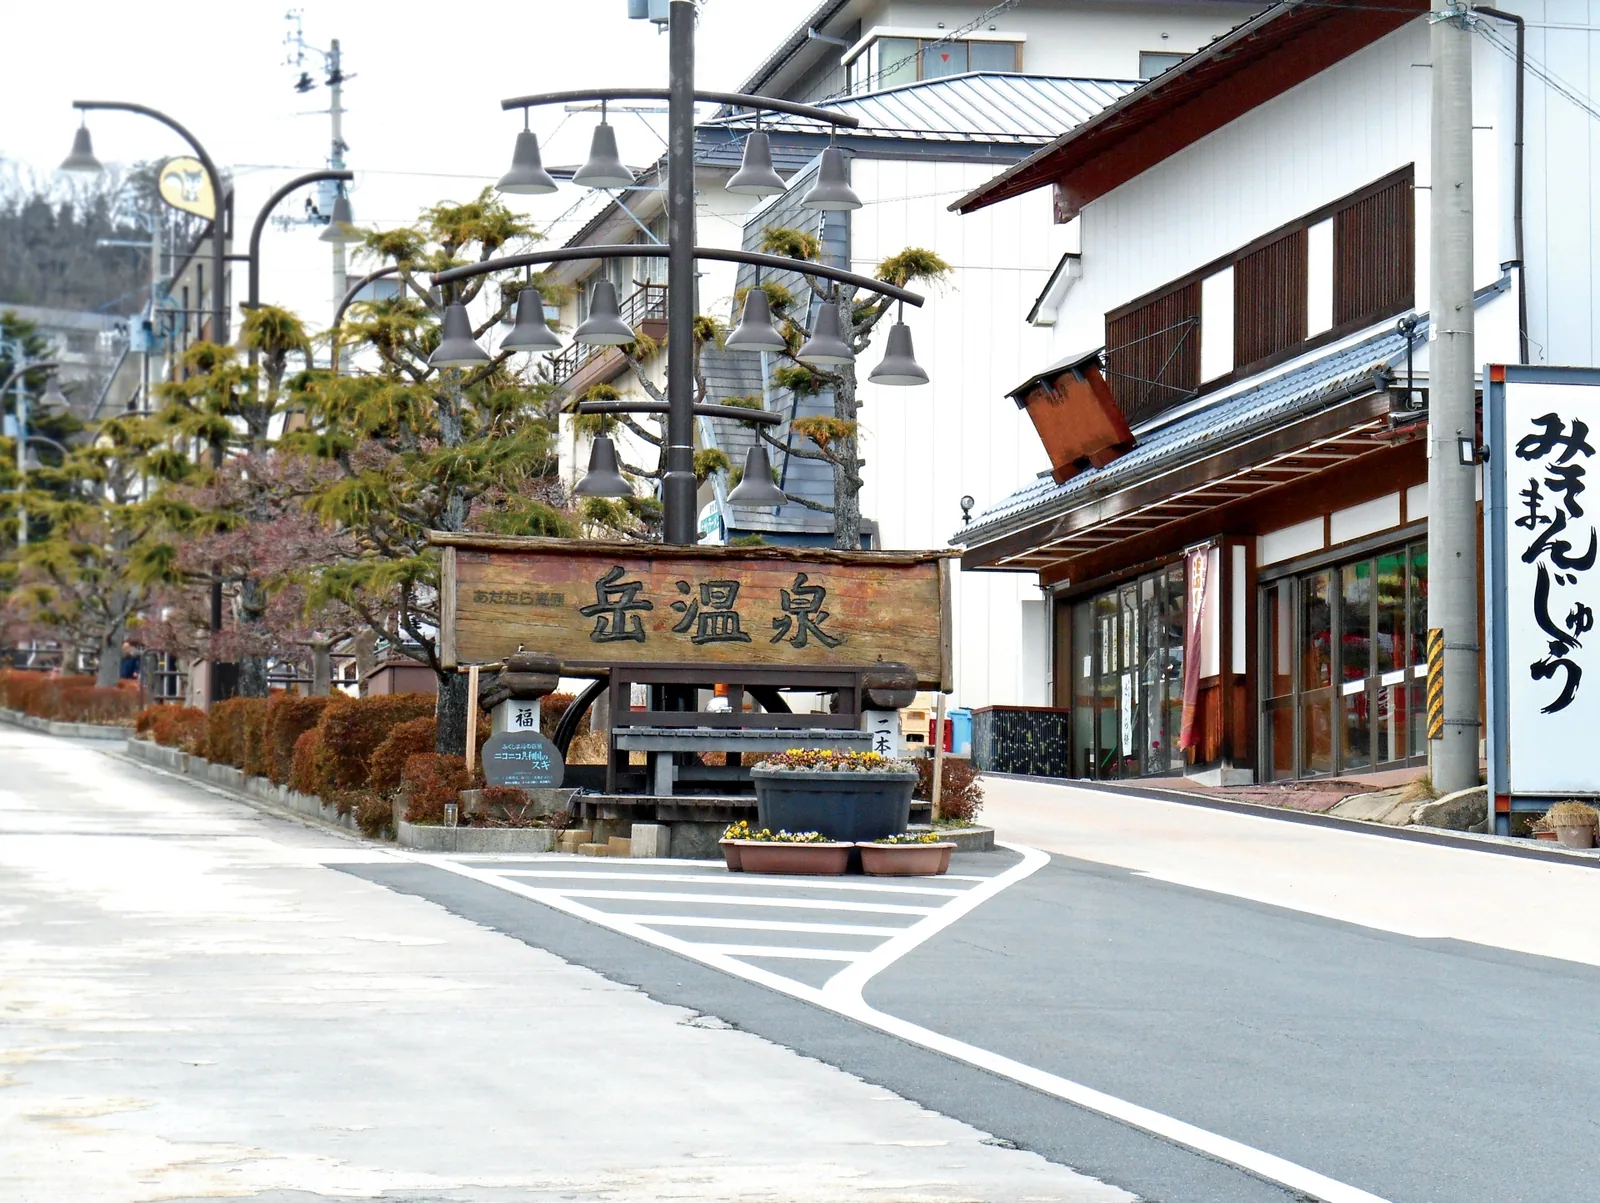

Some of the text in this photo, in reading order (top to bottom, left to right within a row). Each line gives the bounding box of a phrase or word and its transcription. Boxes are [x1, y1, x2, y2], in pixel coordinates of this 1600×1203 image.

[1515, 411, 1597, 715] みそまんじゅう
[579, 565, 843, 649] 岳温泉
[515, 708, 534, 727] 福
[531, 760, 551, 770] スギ
